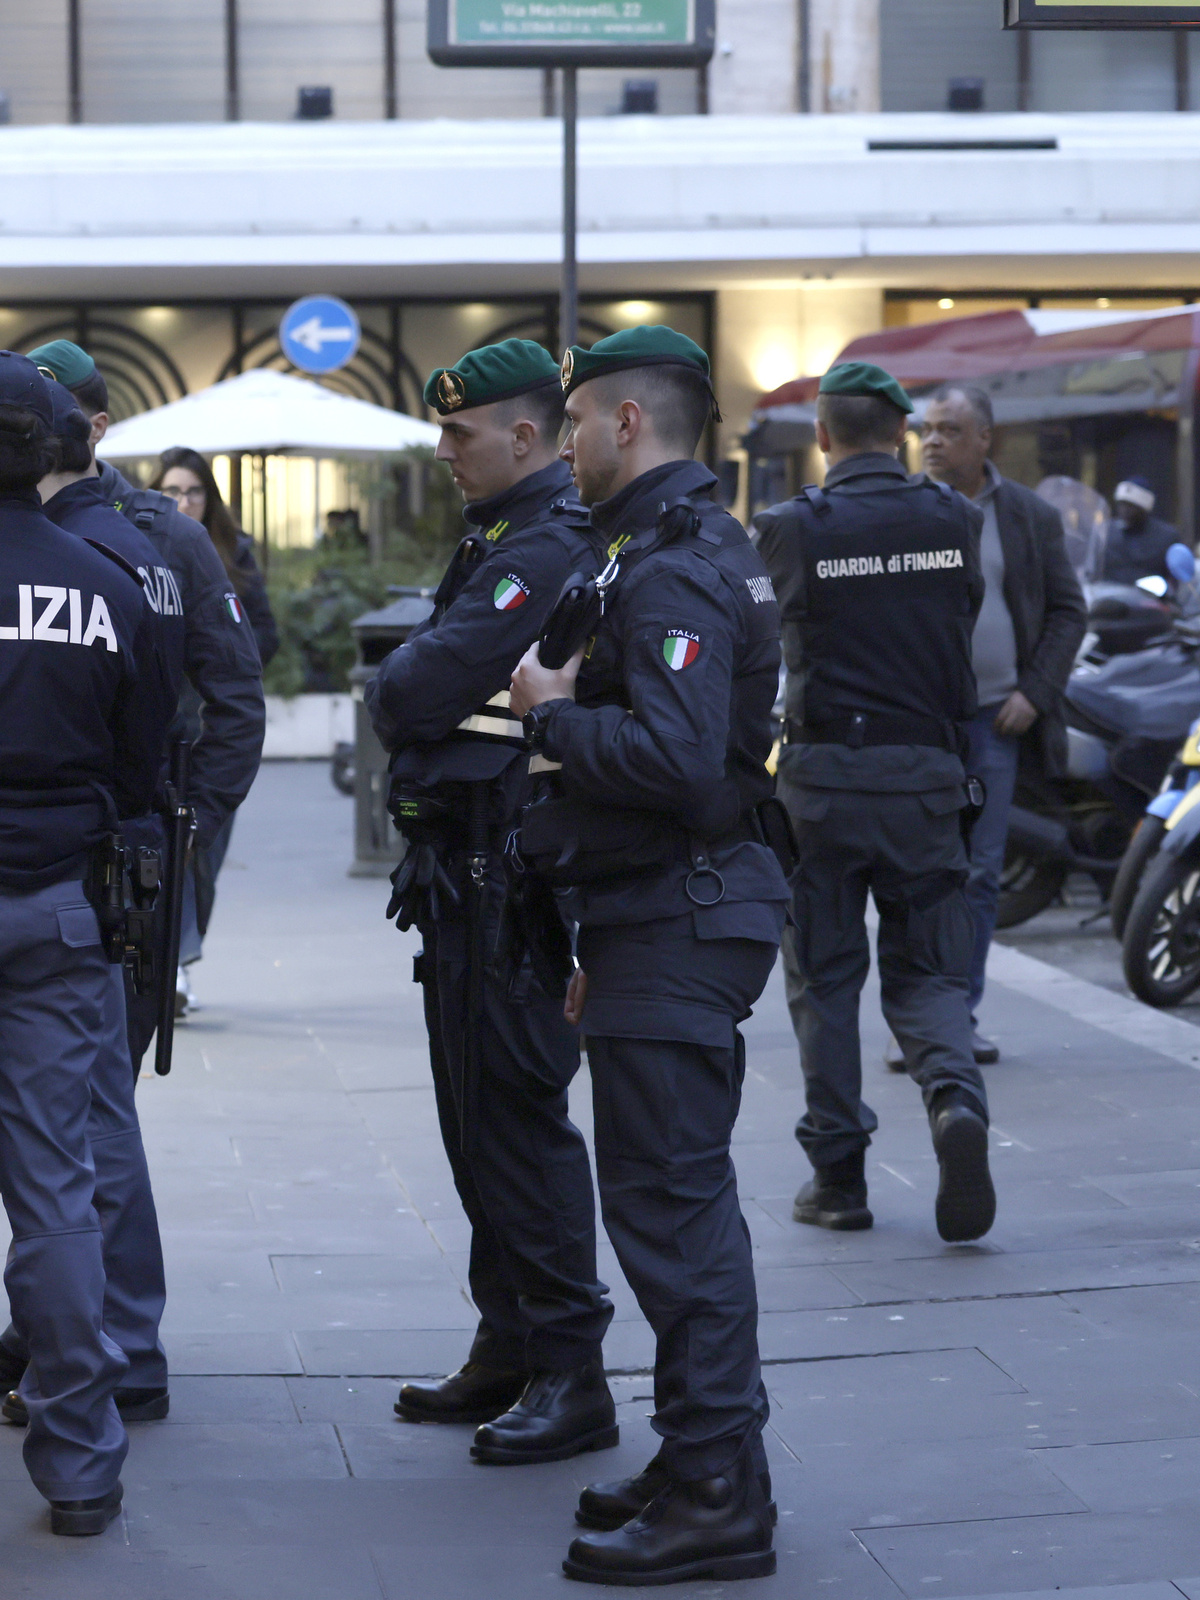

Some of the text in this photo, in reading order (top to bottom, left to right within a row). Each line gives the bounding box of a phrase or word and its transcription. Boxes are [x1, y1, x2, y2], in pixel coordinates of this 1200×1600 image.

[816, 549, 964, 579] GUARDIA di FINANZA
[507, 572, 531, 597] ITALIA
[667, 629, 700, 643] ITALIA
